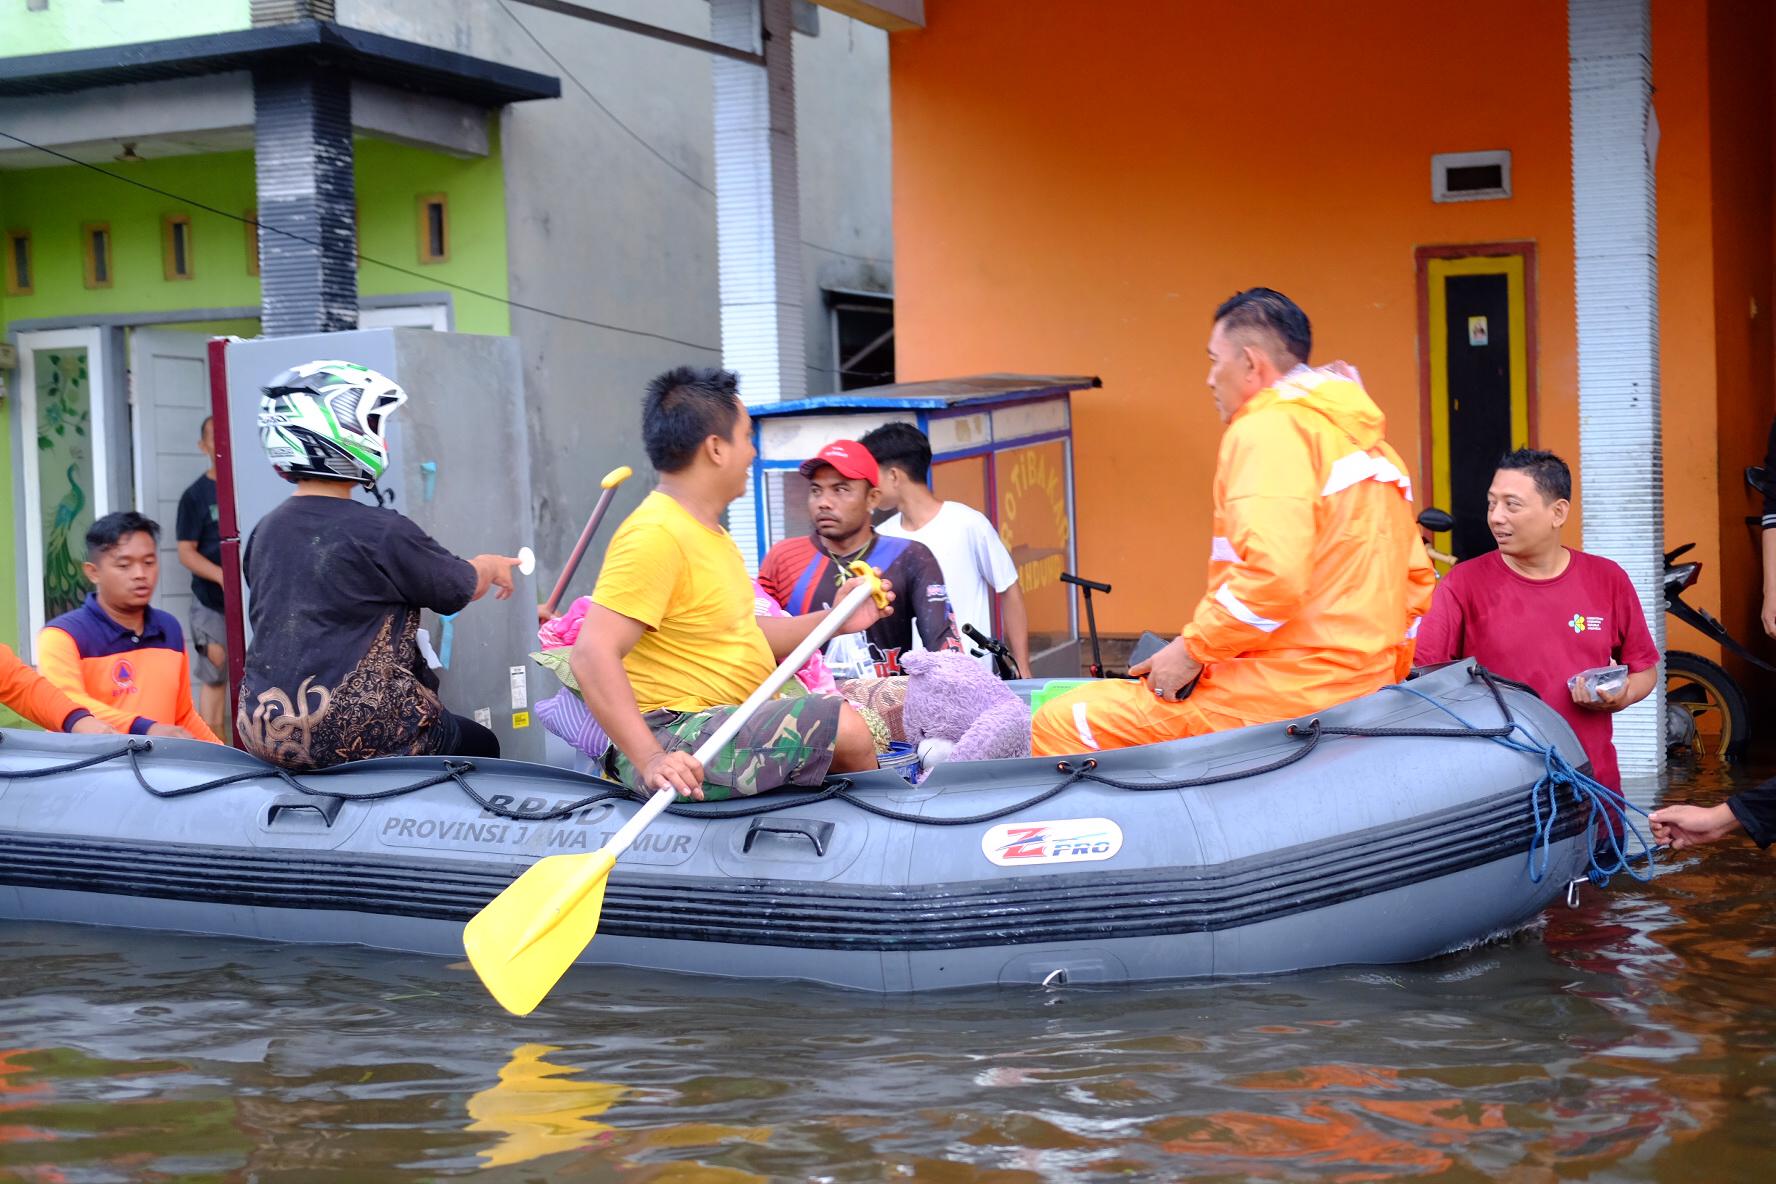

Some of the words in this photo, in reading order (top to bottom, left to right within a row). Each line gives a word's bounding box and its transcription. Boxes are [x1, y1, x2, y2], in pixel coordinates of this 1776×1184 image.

[382, 816, 511, 844] PROVINSI
[512, 826, 587, 849] JWA
[600, 831, 692, 854] TMUR
[1052, 841, 1110, 856] PRO
